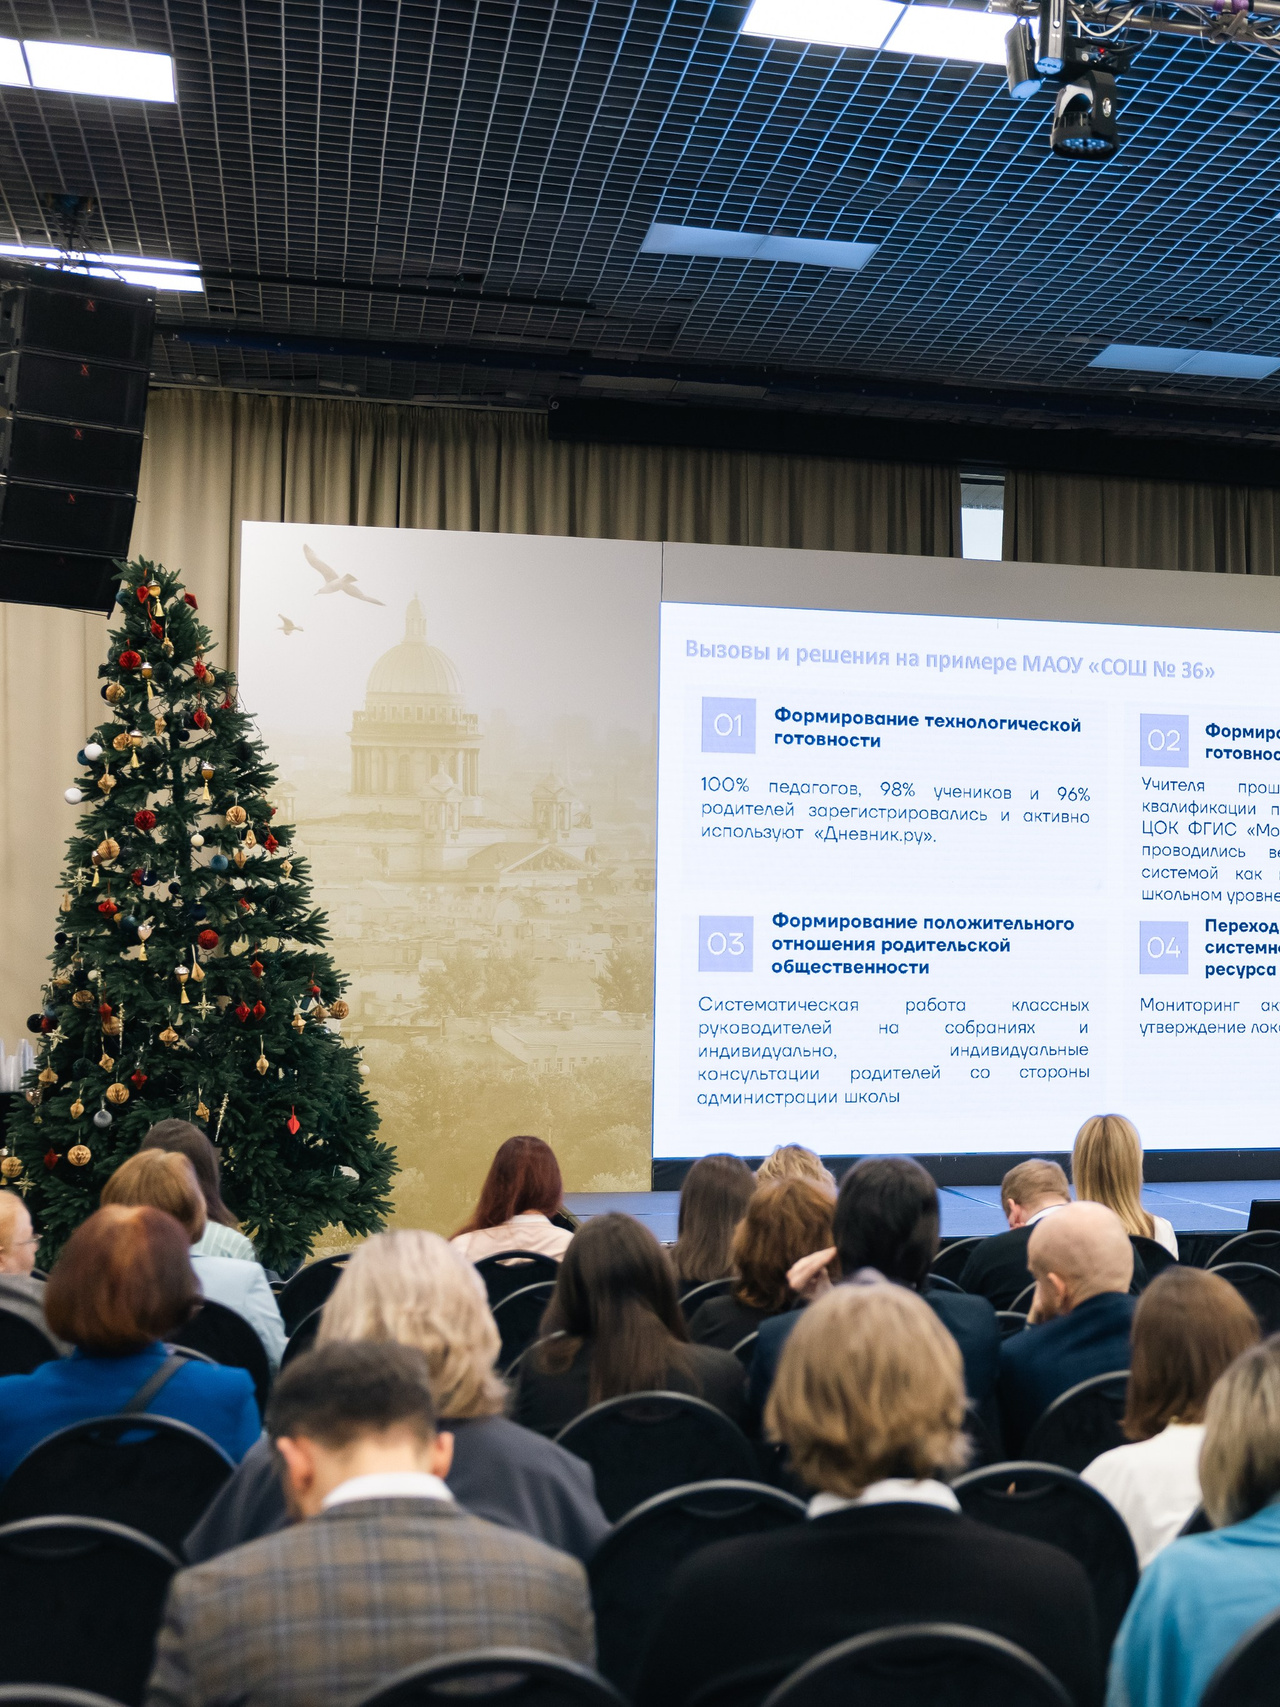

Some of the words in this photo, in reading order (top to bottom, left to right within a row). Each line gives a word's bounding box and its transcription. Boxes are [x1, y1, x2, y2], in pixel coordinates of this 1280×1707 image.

[686, 639, 771, 661] Вызовы
[776, 646, 790, 662] и
[796, 647, 890, 667] решения
[896, 652, 920, 667] на
[926, 653, 1017, 675] примере
[1022, 654, 1084, 674] МАОУ
[1088, 657, 1147, 677] «СОШ
[1153, 660, 1176, 678] №
[1181, 661, 1216, 680] 36»
[713, 713, 742, 737] 01
[774, 706, 920, 728] Формирование
[924, 715, 1081, 733] технологической
[774, 733, 881, 748] готовности
[1147, 728, 1181, 752] 02
[701, 776, 750, 793] 100%
[769, 782, 862, 798] педагогов,
[879, 781, 916, 797] 98%
[933, 786, 1012, 802] учеников
[1030, 789, 1039, 801] и
[1057, 786, 1091, 802] 96%
[1141, 776, 1205, 792] Учителя
[701, 801, 795, 818] родителей
[808, 806, 988, 823] зарегистрировались
[1000, 811, 1010, 822] и
[1022, 811, 1090, 824] активно
[1142, 799, 1256, 817] квалификации
[701, 826, 804, 843] используют
[814, 825, 937, 846] «Дневник.ру».
[1142, 819, 1179, 837] ЦОК
[1187, 820, 1237, 837] ФГИС
[1142, 845, 1246, 860] проводились
[1141, 865, 1218, 880] системой
[1235, 869, 1263, 881] как
[1142, 889, 1222, 902] школьном
[772, 911, 918, 932] Формирование
[923, 917, 1075, 931] положительного
[1205, 918, 1280, 936] Переход
[707, 932, 745, 956] 03
[771, 939, 876, 952] отношения
[881, 937, 1011, 955] родительской
[1147, 936, 1181, 959] 04
[771, 959, 930, 976] общественности
[1205, 964, 1277, 980] ресурса
[698, 996, 859, 1012] Систематическая
[905, 996, 966, 1015] работа
[1012, 1000, 1090, 1012] классных
[1140, 997, 1241, 1015] Мониторинг
[698, 1019, 832, 1039] руководителей
[878, 1023, 899, 1035] на
[944, 1019, 1036, 1038] собраниях
[1079, 1023, 1088, 1034] и
[1139, 1023, 1247, 1038] утверждение
[698, 1046, 837, 1061] индивидуально,
[950, 1045, 1089, 1060] индивидуальные
[698, 1069, 820, 1085] консультации
[850, 1064, 941, 1084] родителей
[970, 1068, 991, 1079] со
[1019, 1067, 1090, 1082] стороны
[696, 1092, 838, 1108] администрации
[844, 1091, 900, 1104] школы
